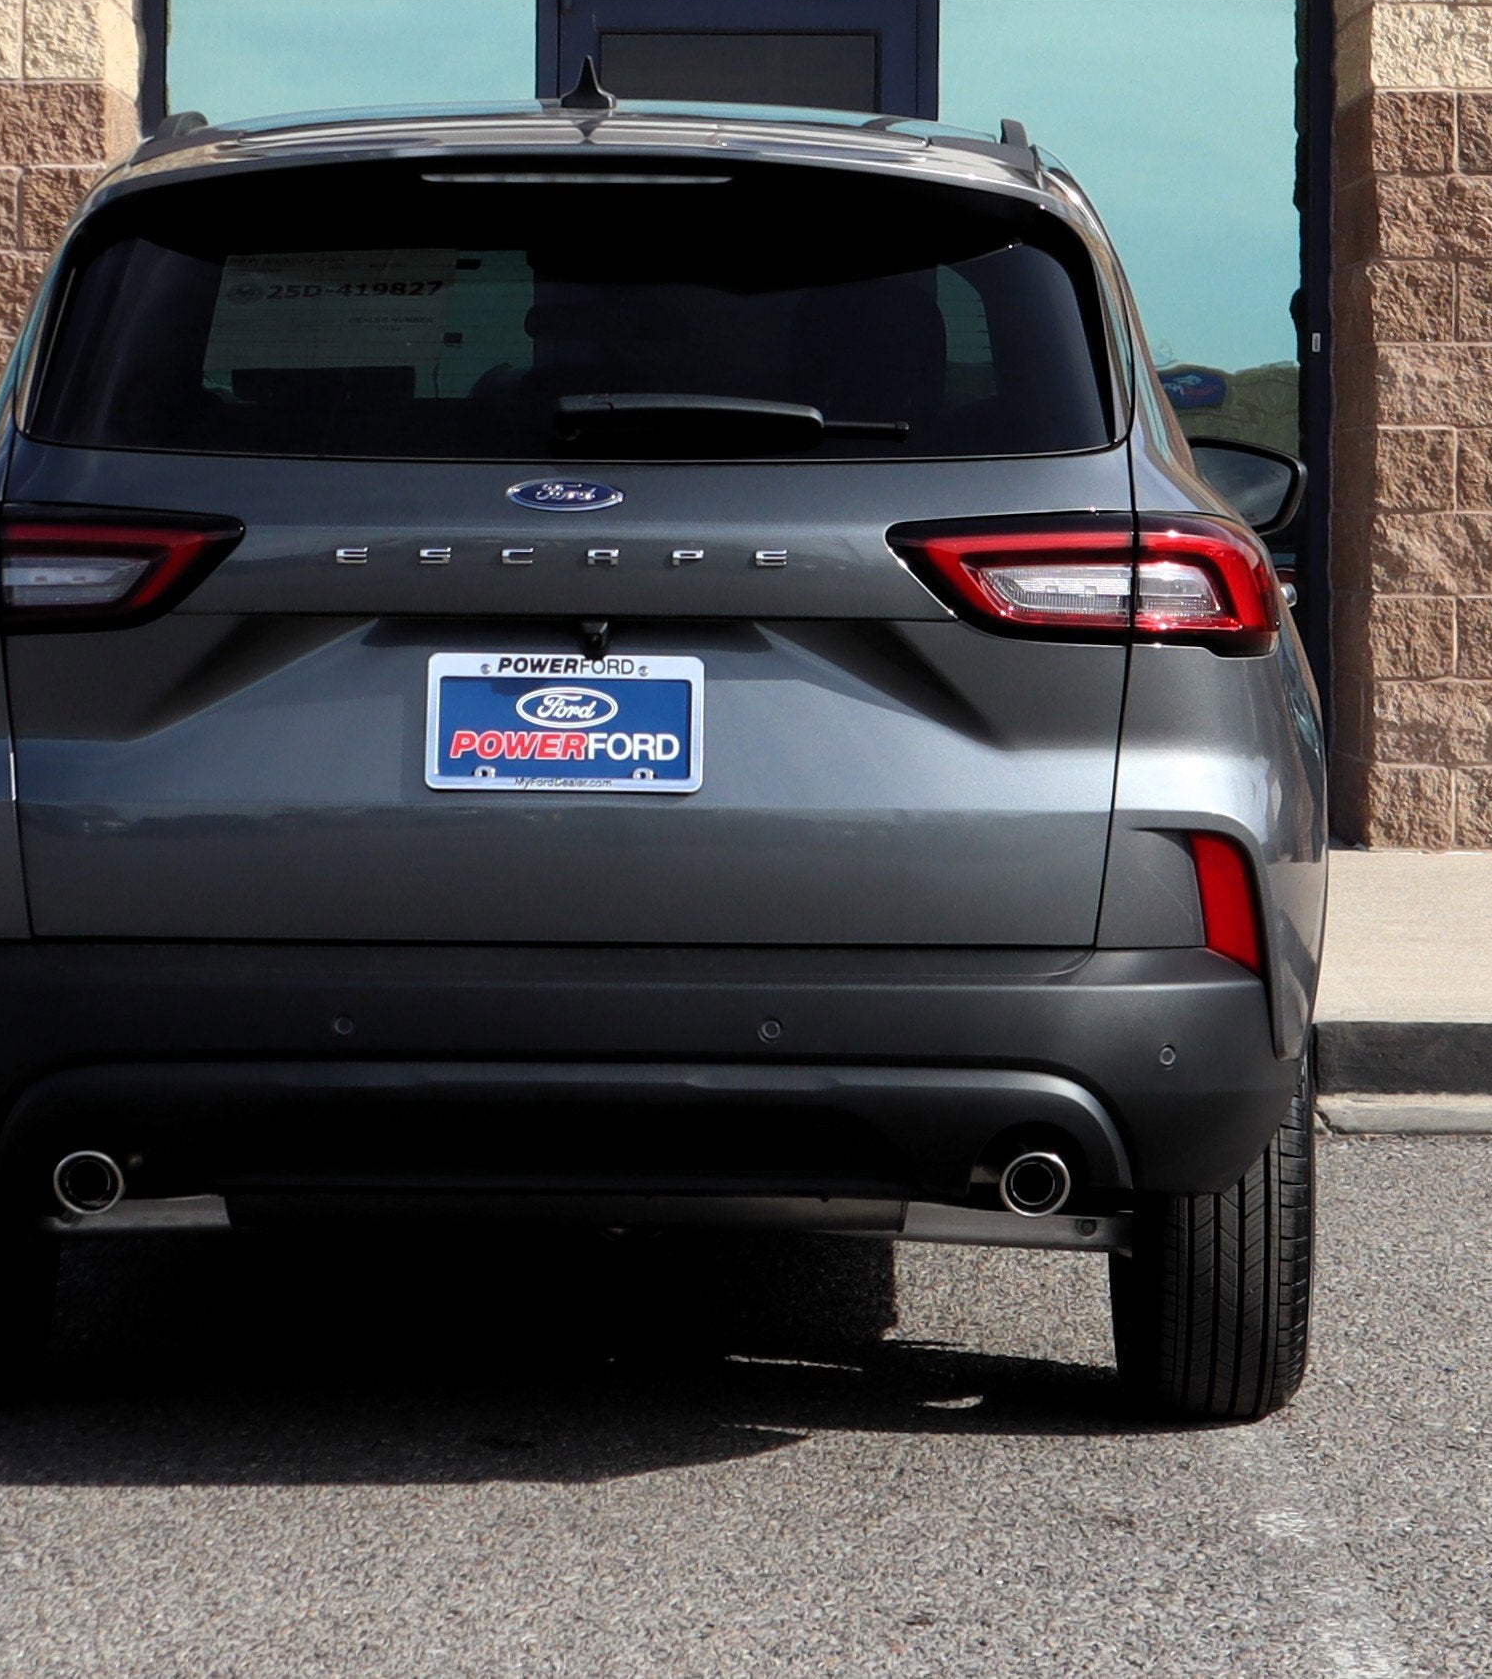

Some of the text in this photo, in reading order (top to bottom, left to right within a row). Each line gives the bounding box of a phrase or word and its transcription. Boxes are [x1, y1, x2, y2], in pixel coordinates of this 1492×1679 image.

[265, 280, 444, 301] 25D-419827
[535, 483, 596, 501] Ford
[336, 546, 788, 567] ESCAPE
[497, 656, 635, 675] POWERFORD
[536, 693, 597, 720] Ford
[449, 730, 681, 761] POWERFORD
